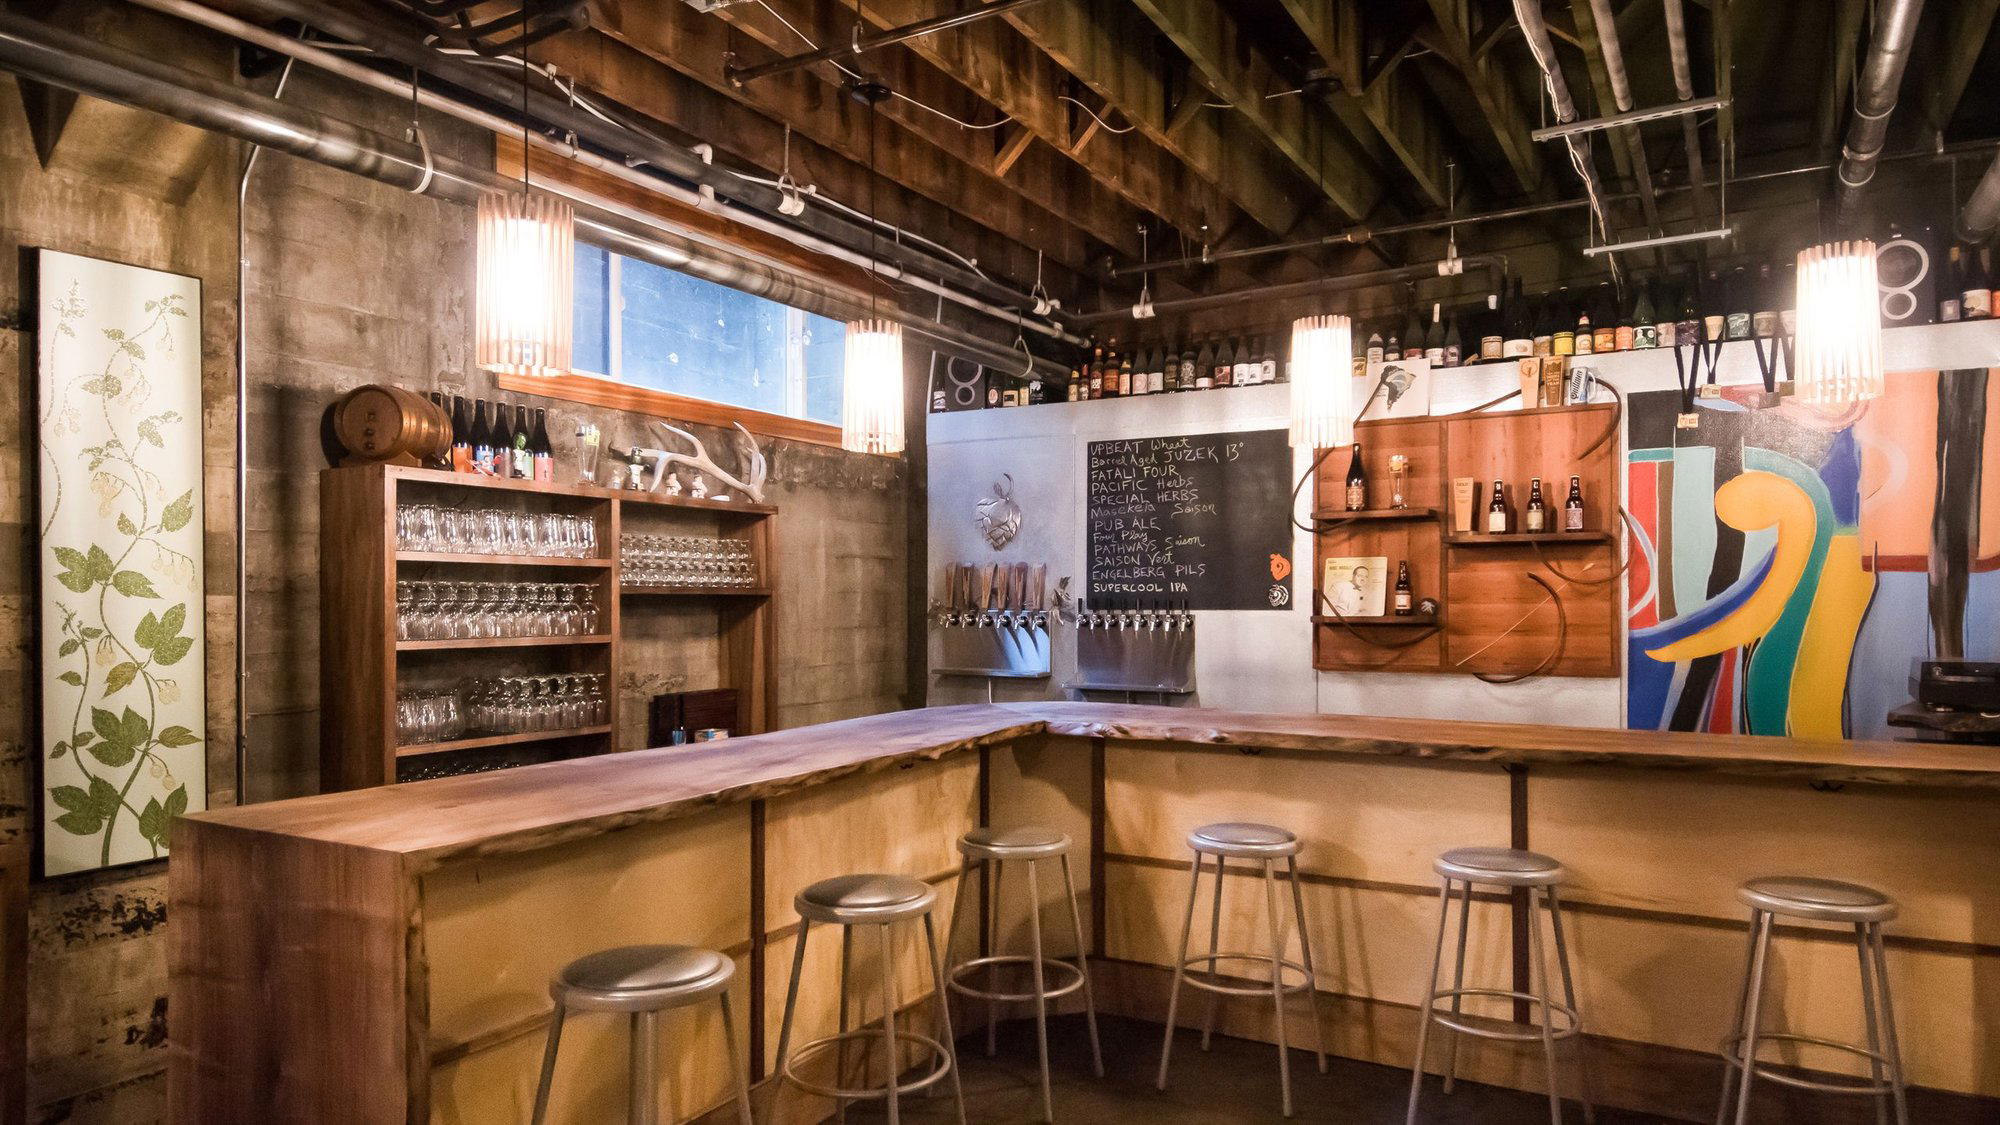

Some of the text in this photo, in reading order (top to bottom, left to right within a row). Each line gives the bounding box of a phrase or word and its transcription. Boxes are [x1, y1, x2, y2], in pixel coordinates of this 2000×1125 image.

[1090, 437, 1191, 456] UPBEAT Wheat
[1091, 455, 1128, 468] Barrel
[1130, 453, 1158, 467] Aged
[1164, 446, 1219, 463] JUZEK
[1091, 464, 1180, 481] FATALI FOUR
[1091, 475, 1195, 495] PACIFIC Herbs
[1092, 488, 1199, 505] SPECIAL HERBS
[1171, 502, 1217, 519] Saison
[1095, 516, 1161, 531] PUB ALE
[1121, 530, 1148, 542] Play
[1094, 534, 1206, 556] PATHWAYS Saison
[1092, 552, 1141, 570] SAISON
[1092, 563, 1206, 580] ENGELBERG PILS
[1093, 582, 1188, 593] SUPERCOOL IPA
